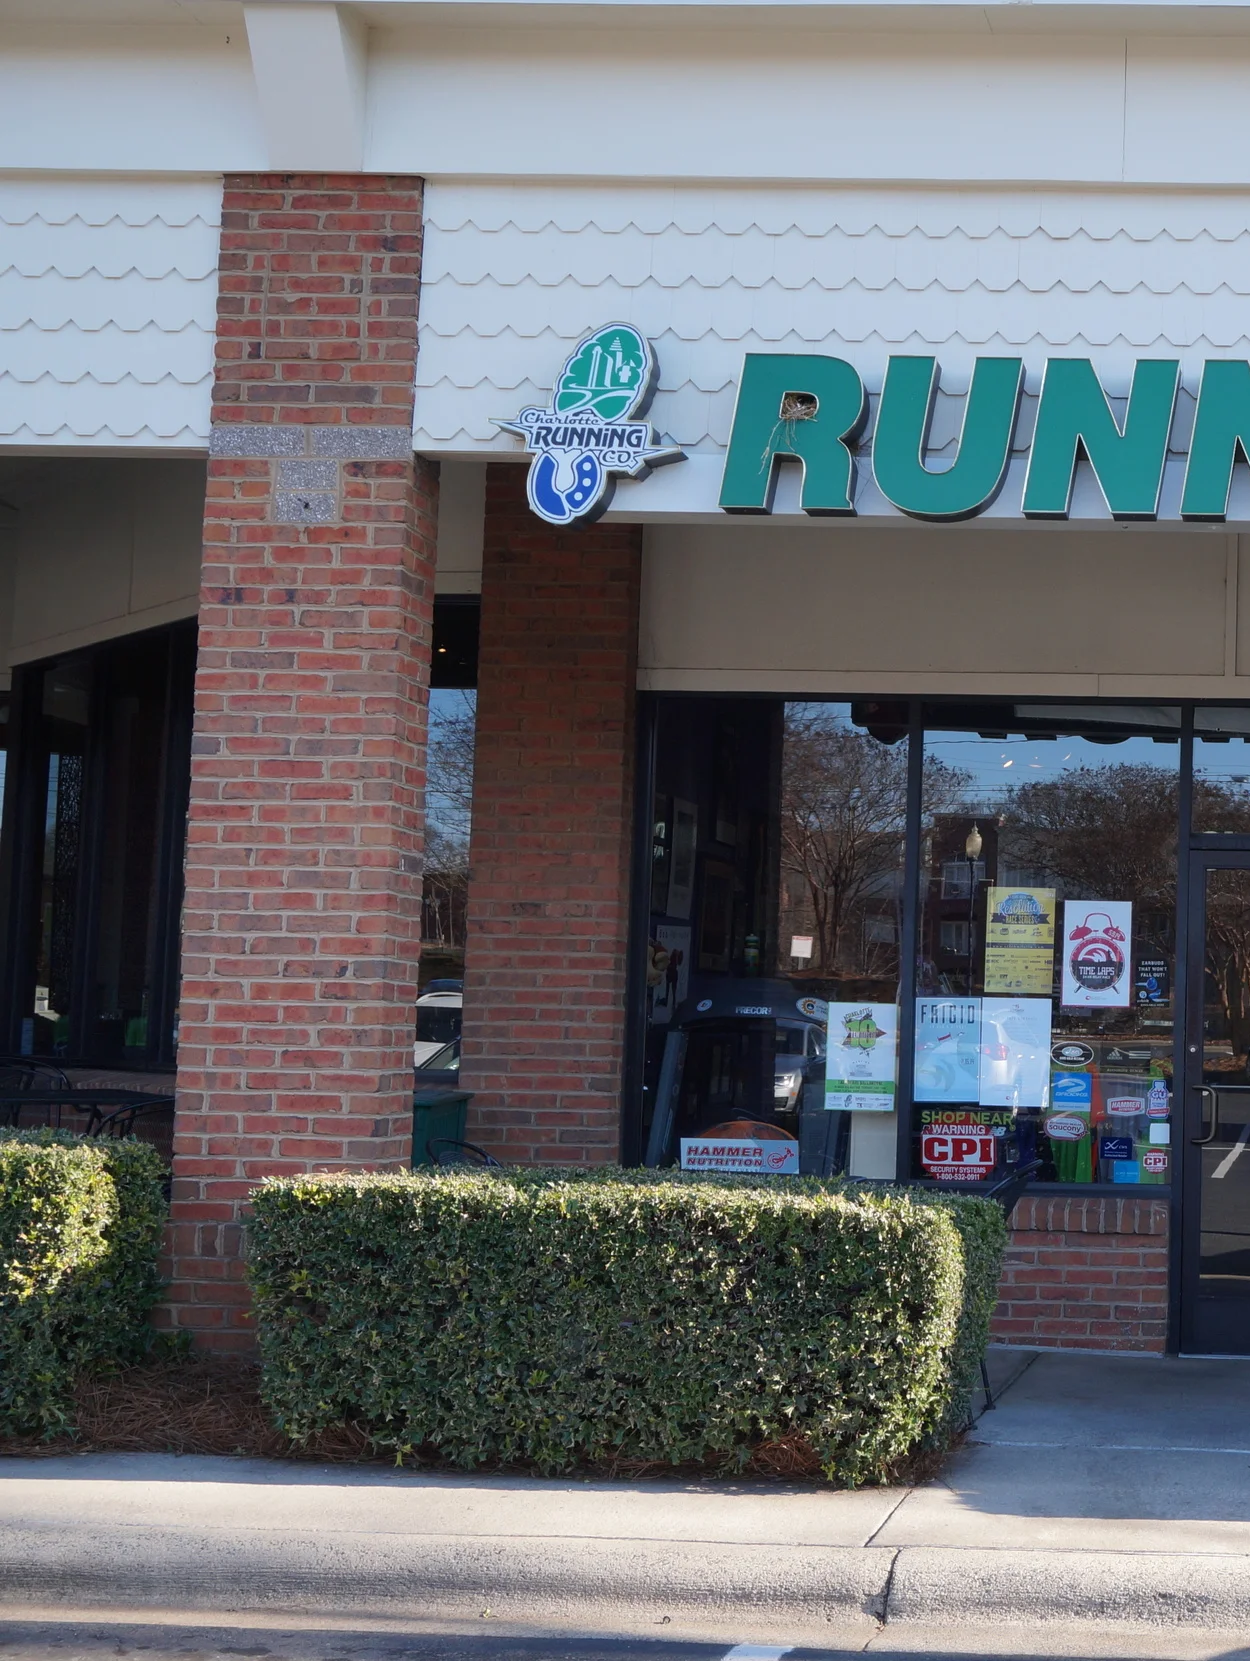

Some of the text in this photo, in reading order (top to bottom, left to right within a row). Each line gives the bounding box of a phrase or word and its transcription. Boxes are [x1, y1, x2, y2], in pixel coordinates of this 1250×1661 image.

[524, 411, 599, 426] Charlotte
[602, 450, 634, 464] CO.
[1079, 966, 1115, 976] TIME LAPS
[735, 1006, 768, 1015] PRECOR
[920, 1004, 975, 1025] FRIGID
[1151, 1091, 1167, 1099] GU
[1111, 1100, 1141, 1109] HAMMER
[920, 1111, 966, 1124] SHOP
[931, 1124, 986, 1135] WARNING
[1048, 1124, 1081, 1133] saucony
[687, 1146, 764, 1157] HAMMER
[924, 1137, 993, 1163] CPI
[687, 1158, 763, 1168] NUTRITION
[1143, 1157, 1168, 1166] CPI
[930, 1165, 987, 1174] SECURITY SYSTEMS
[936, 1173, 980, 1181] 1-800-532-0911
